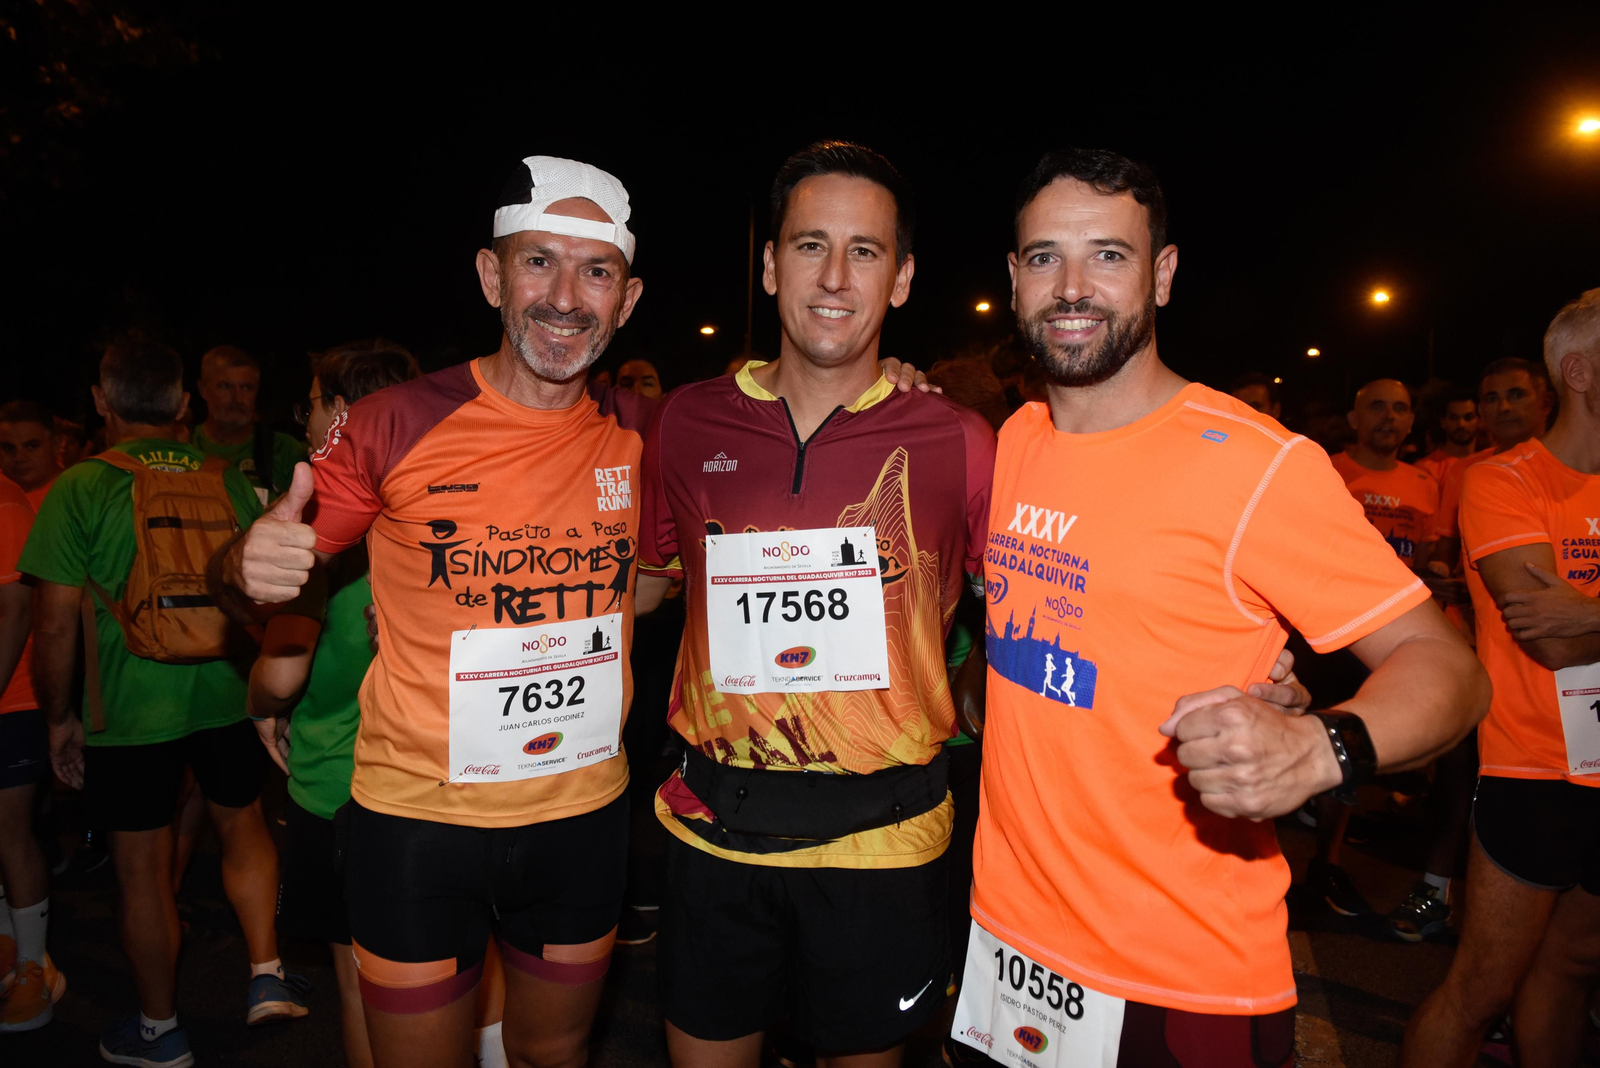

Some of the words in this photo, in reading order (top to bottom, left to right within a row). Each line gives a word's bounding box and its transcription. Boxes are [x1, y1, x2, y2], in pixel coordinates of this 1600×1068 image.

[594, 465, 631, 483] RETT
[702, 460, 738, 473] HORIZON
[596, 480, 632, 497] TRAIL
[1364, 493, 1401, 508] XXXV
[486, 524, 551, 541] Pasito
[566, 527, 583, 539] a
[591, 521, 627, 537] Paso
[1007, 502, 1079, 544] XXXV
[449, 541, 613, 578] SÍNDROME
[987, 531, 1025, 554] CARRERA
[1028, 542, 1090, 573] NOCTURNA
[753, 574, 786, 582] NOCTURNA
[798, 571, 845, 580] GUADALQUIVIR
[987, 547, 1087, 594] GUADALQUIVIR
[455, 586, 489, 608] de
[490, 580, 606, 625] RETT
[736, 588, 850, 624] 17568
[479, 670, 509, 679] CARRERA
[509, 666, 542, 676] NOCTURNA
[553, 658, 594, 670] GUADALQUIVIR
[594, 656, 603, 664] KH7
[603, 653, 615, 661] 2023
[834, 673, 881, 682] Cruzcampo
[498, 675, 586, 717] 7632
[498, 722, 521, 731] JUAN
[521, 717, 552, 729] CARLOS
[553, 711, 585, 723] GODINEZ
[577, 744, 612, 760] Cruzcampo
[994, 947, 1085, 1021] 10558
[1000, 993, 1021, 1009] ISIDRO
[1022, 1004, 1048, 1023] PASTOR
[1048, 1017, 1067, 1034] PEREZ
